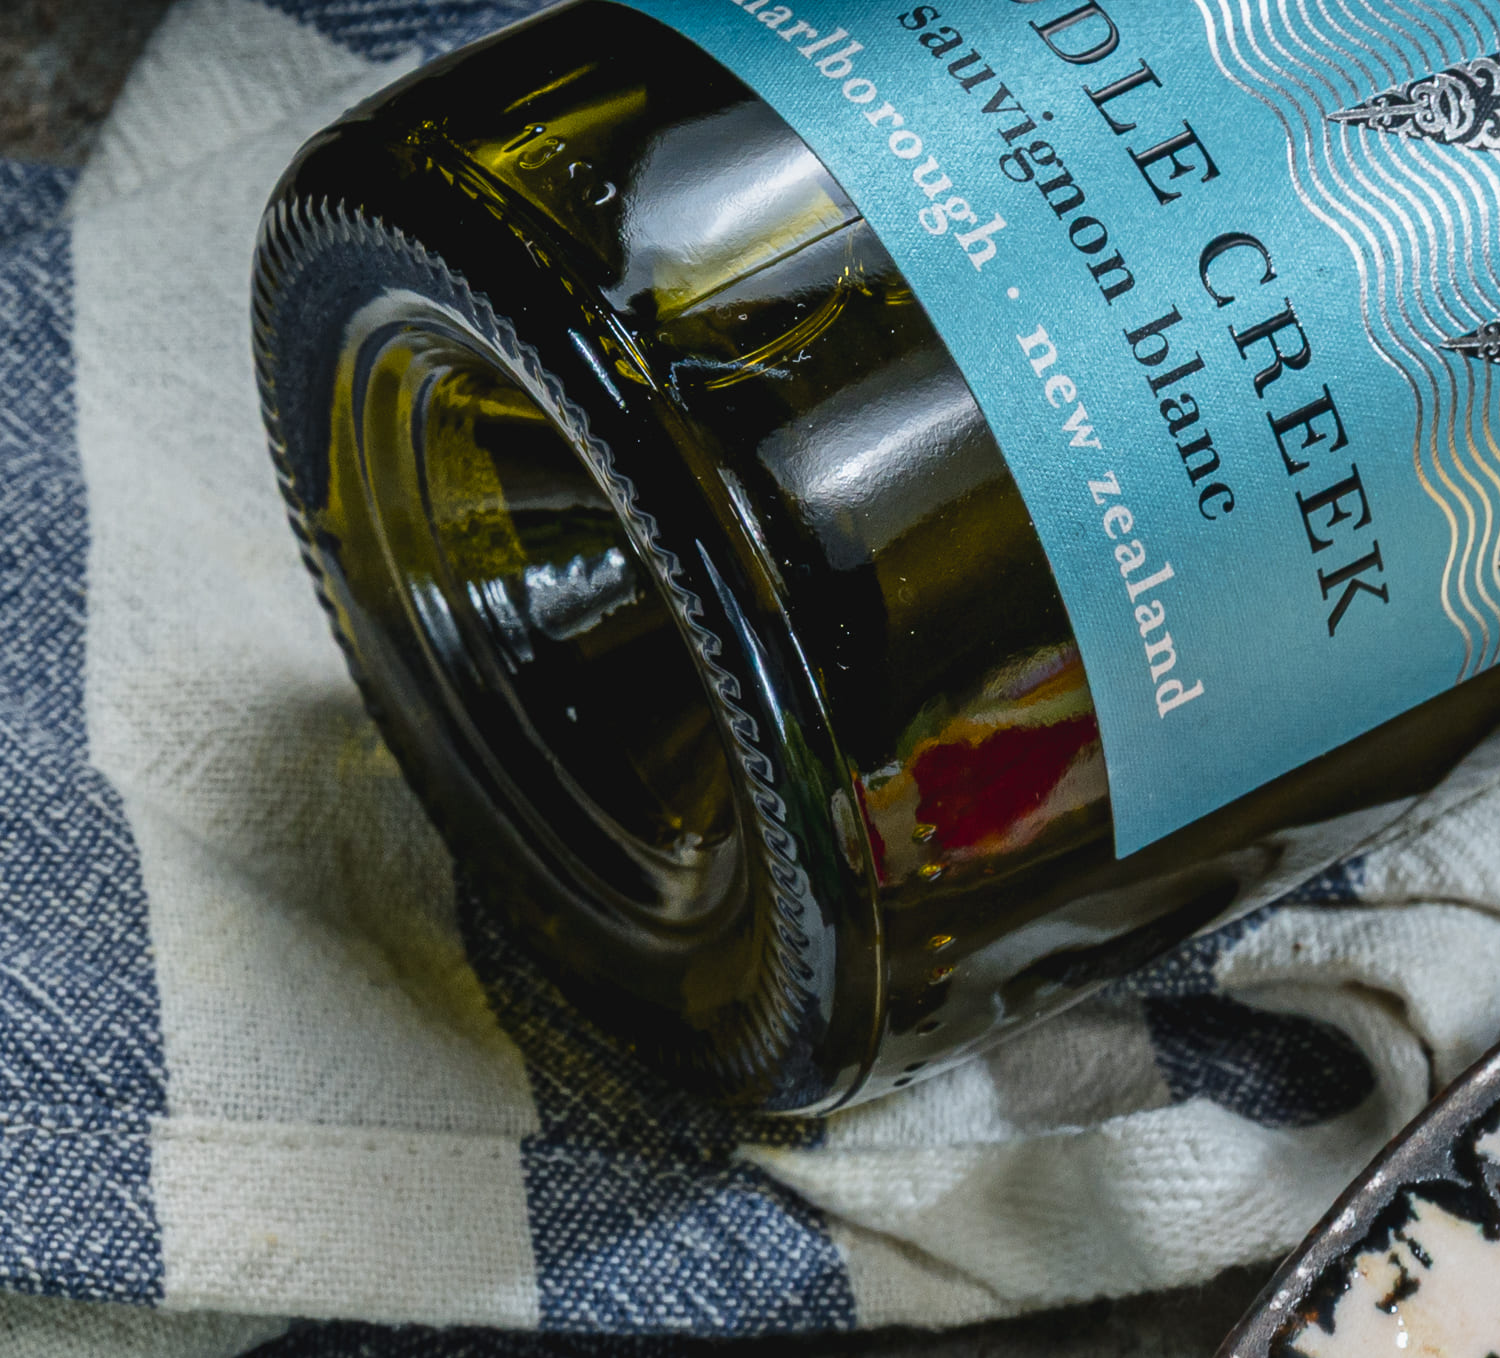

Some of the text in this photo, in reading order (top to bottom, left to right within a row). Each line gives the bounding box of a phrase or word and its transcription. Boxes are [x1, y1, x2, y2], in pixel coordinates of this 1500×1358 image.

[896, 4, 1236, 522] sauvignon blanc
[1003, 0, 1390, 638] DLE CREEK
[1017, 322, 1104, 454] new
[1087, 469, 1204, 720] zealand
